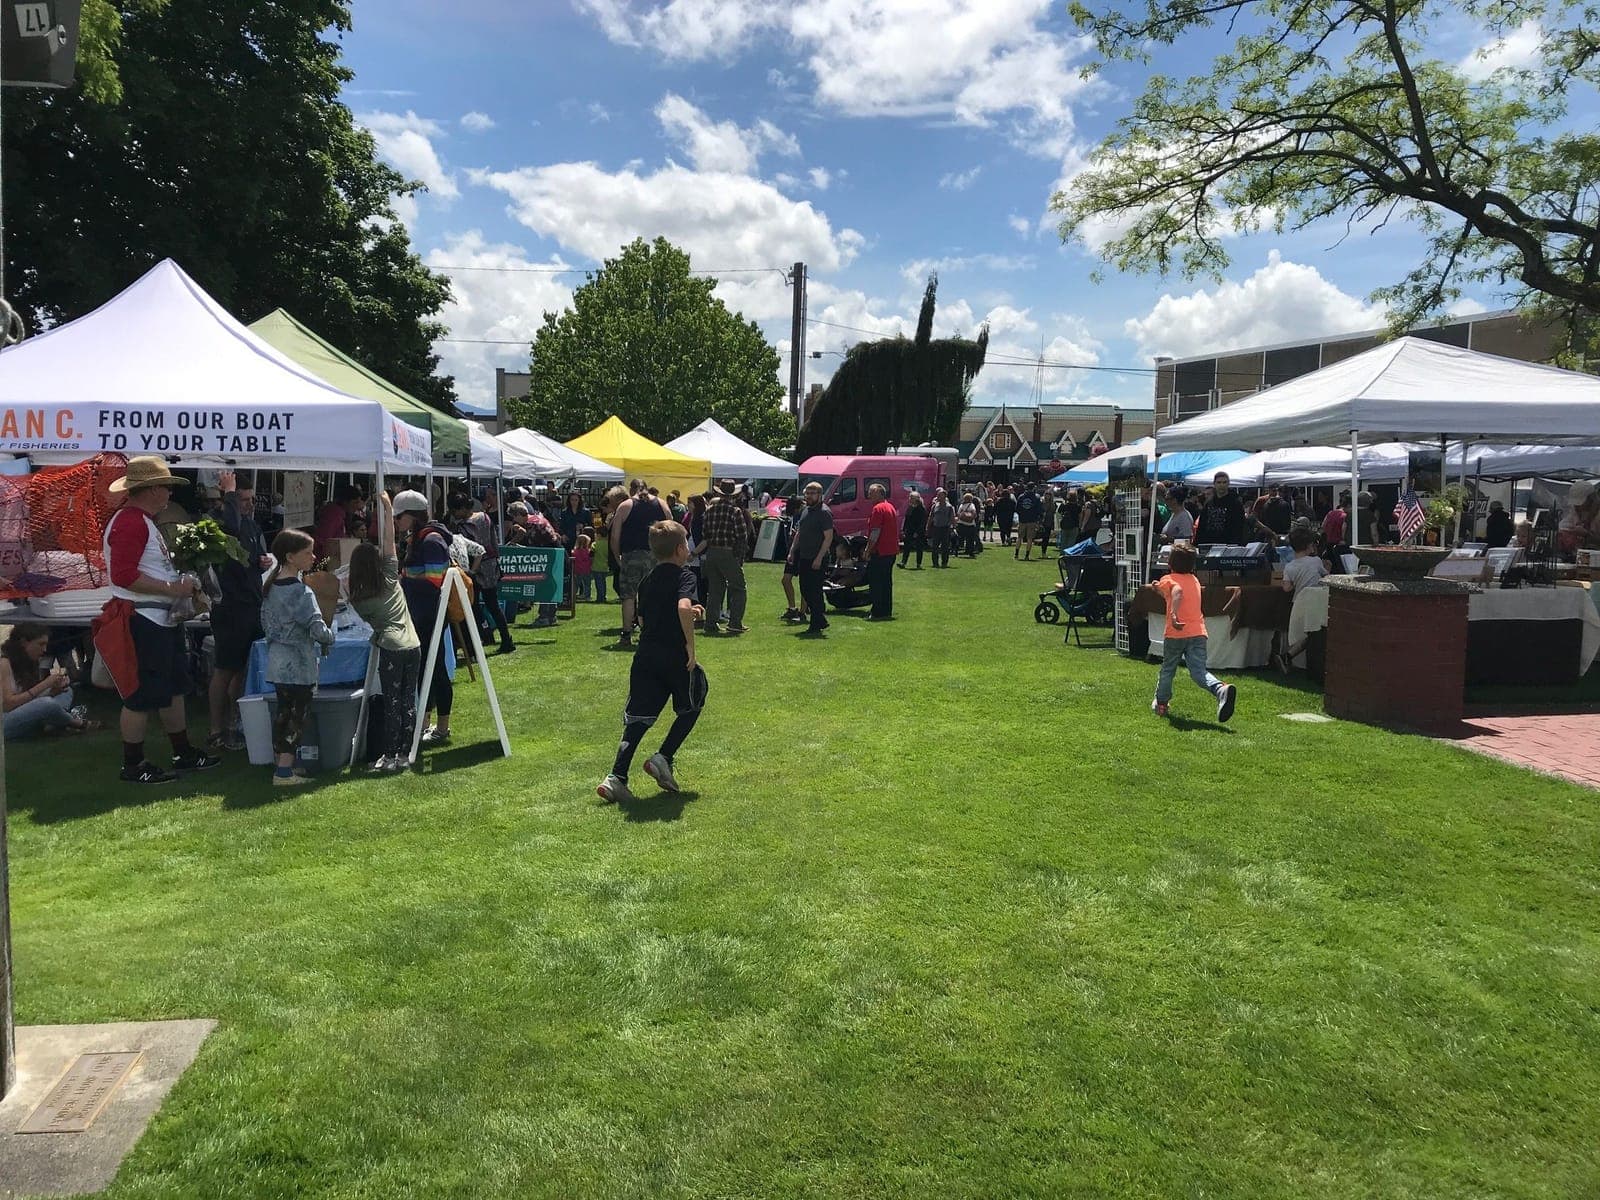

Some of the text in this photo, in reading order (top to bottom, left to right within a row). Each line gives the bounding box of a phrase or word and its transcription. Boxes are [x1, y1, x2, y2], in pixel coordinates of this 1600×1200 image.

[98, 409, 294, 431] FROM OUR BOAT
[9, 442, 80, 450] FISHERIES
[98, 433, 287, 453] TO YOUR TABLE
[500, 564, 547, 573] HIS WHEY
